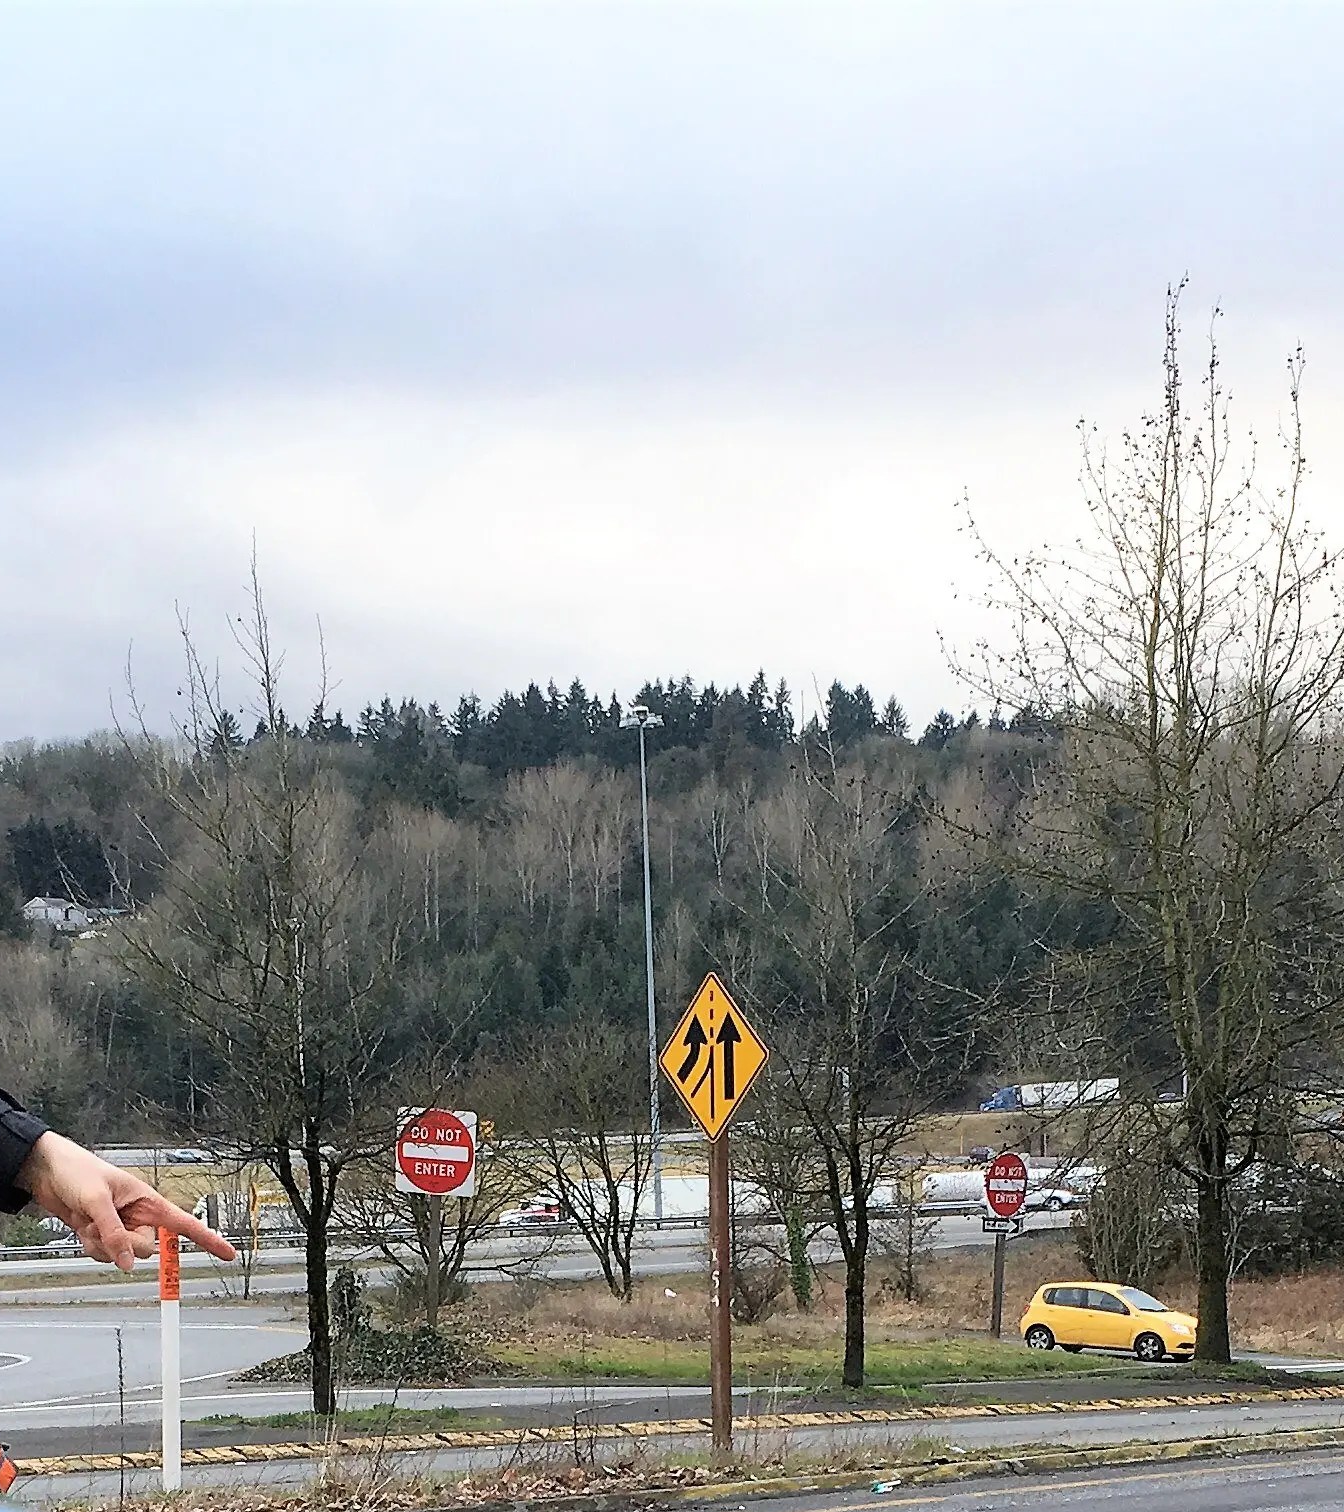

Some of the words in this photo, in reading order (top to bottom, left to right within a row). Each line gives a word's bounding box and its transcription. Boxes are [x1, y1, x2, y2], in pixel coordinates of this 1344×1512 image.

[411, 1126, 429, 1140] DO
[435, 1128, 462, 1142] NOT
[414, 1162, 456, 1178] ENTER
[994, 1165, 1006, 1176] DO
